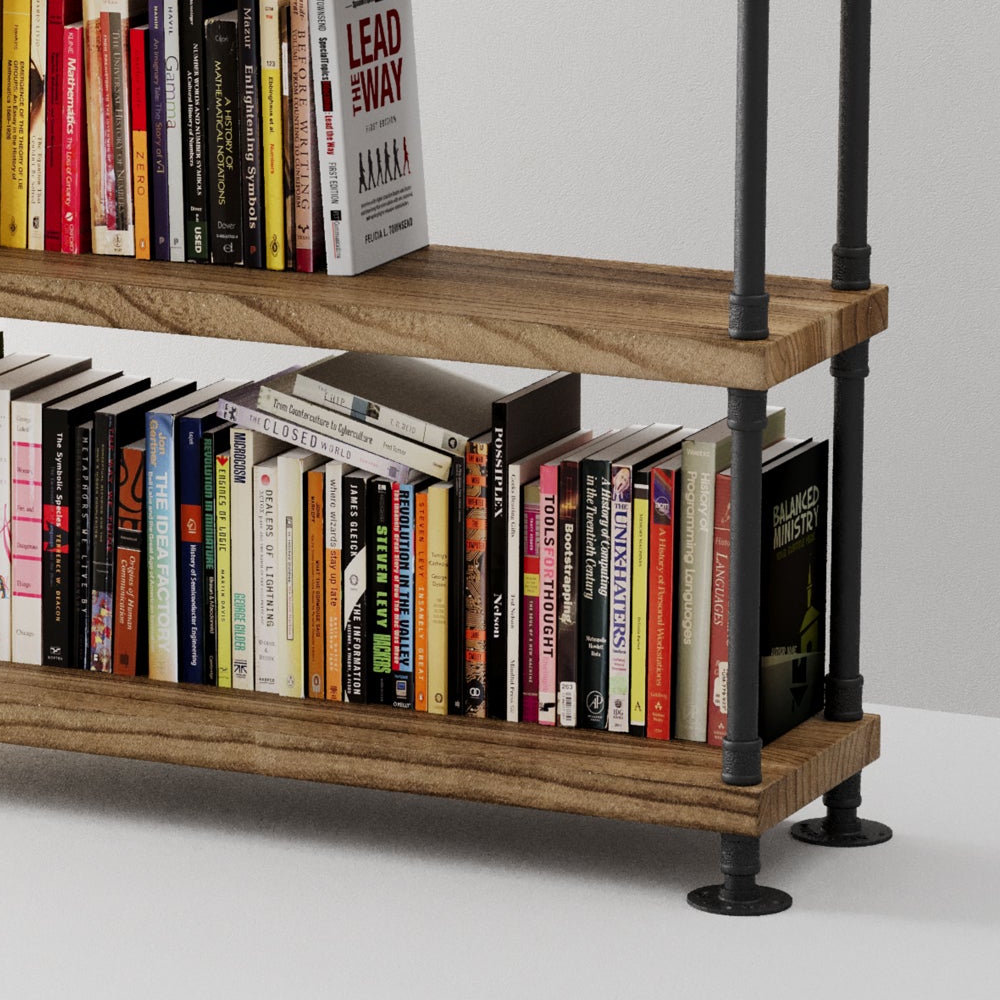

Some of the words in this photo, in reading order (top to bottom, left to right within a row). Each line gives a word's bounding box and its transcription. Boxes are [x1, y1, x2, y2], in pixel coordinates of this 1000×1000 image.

[244, 8, 252, 49] Mazur
[346, 8, 401, 70] LEAD
[66, 58, 76, 134] Mathematics
[214, 61, 223, 143] MATHEMATICAL
[224, 97, 232, 106] A
[352, 71, 360, 116] THE
[362, 57, 403, 113] WAY
[224, 110, 232, 154] HISTORY
[244, 65, 255, 162] Enlightening
[137, 152, 145, 195] ZERO
[217, 146, 225, 206] NOTATIONS
[226, 158, 233, 170] OF
[246, 166, 258, 229] Symbols
[234, 432, 246, 484] MICROCOSM
[494, 427, 503, 517] POSSIPLEX
[155, 472, 168, 511] THE
[349, 484, 359, 517] JAMES
[698, 472, 710, 515] History
[772, 485, 819, 527] BALANCED
[156, 514, 169, 559] IDEA
[349, 521, 358, 556] GLEICK
[399, 490, 409, 561] REVOLUTION
[684, 471, 696, 564] Programming
[699, 518, 710, 532] of
[774, 510, 819, 550] MINISTRY
[376, 525, 388, 583] STEVEN
[399, 565, 409, 580] IN
[561, 524, 574, 623] Bootstrapping
[156, 564, 171, 652] FACTORY
[234, 593, 246, 622] GEORGE
[375, 591, 387, 628] LEVY
[399, 584, 409, 610] THE
[493, 593, 502, 638] Nelson
[683, 569, 695, 645] Languages
[234, 624, 245, 651] GILDER
[373, 634, 391, 673] HACKERS
[399, 614, 409, 666] VALLEY
